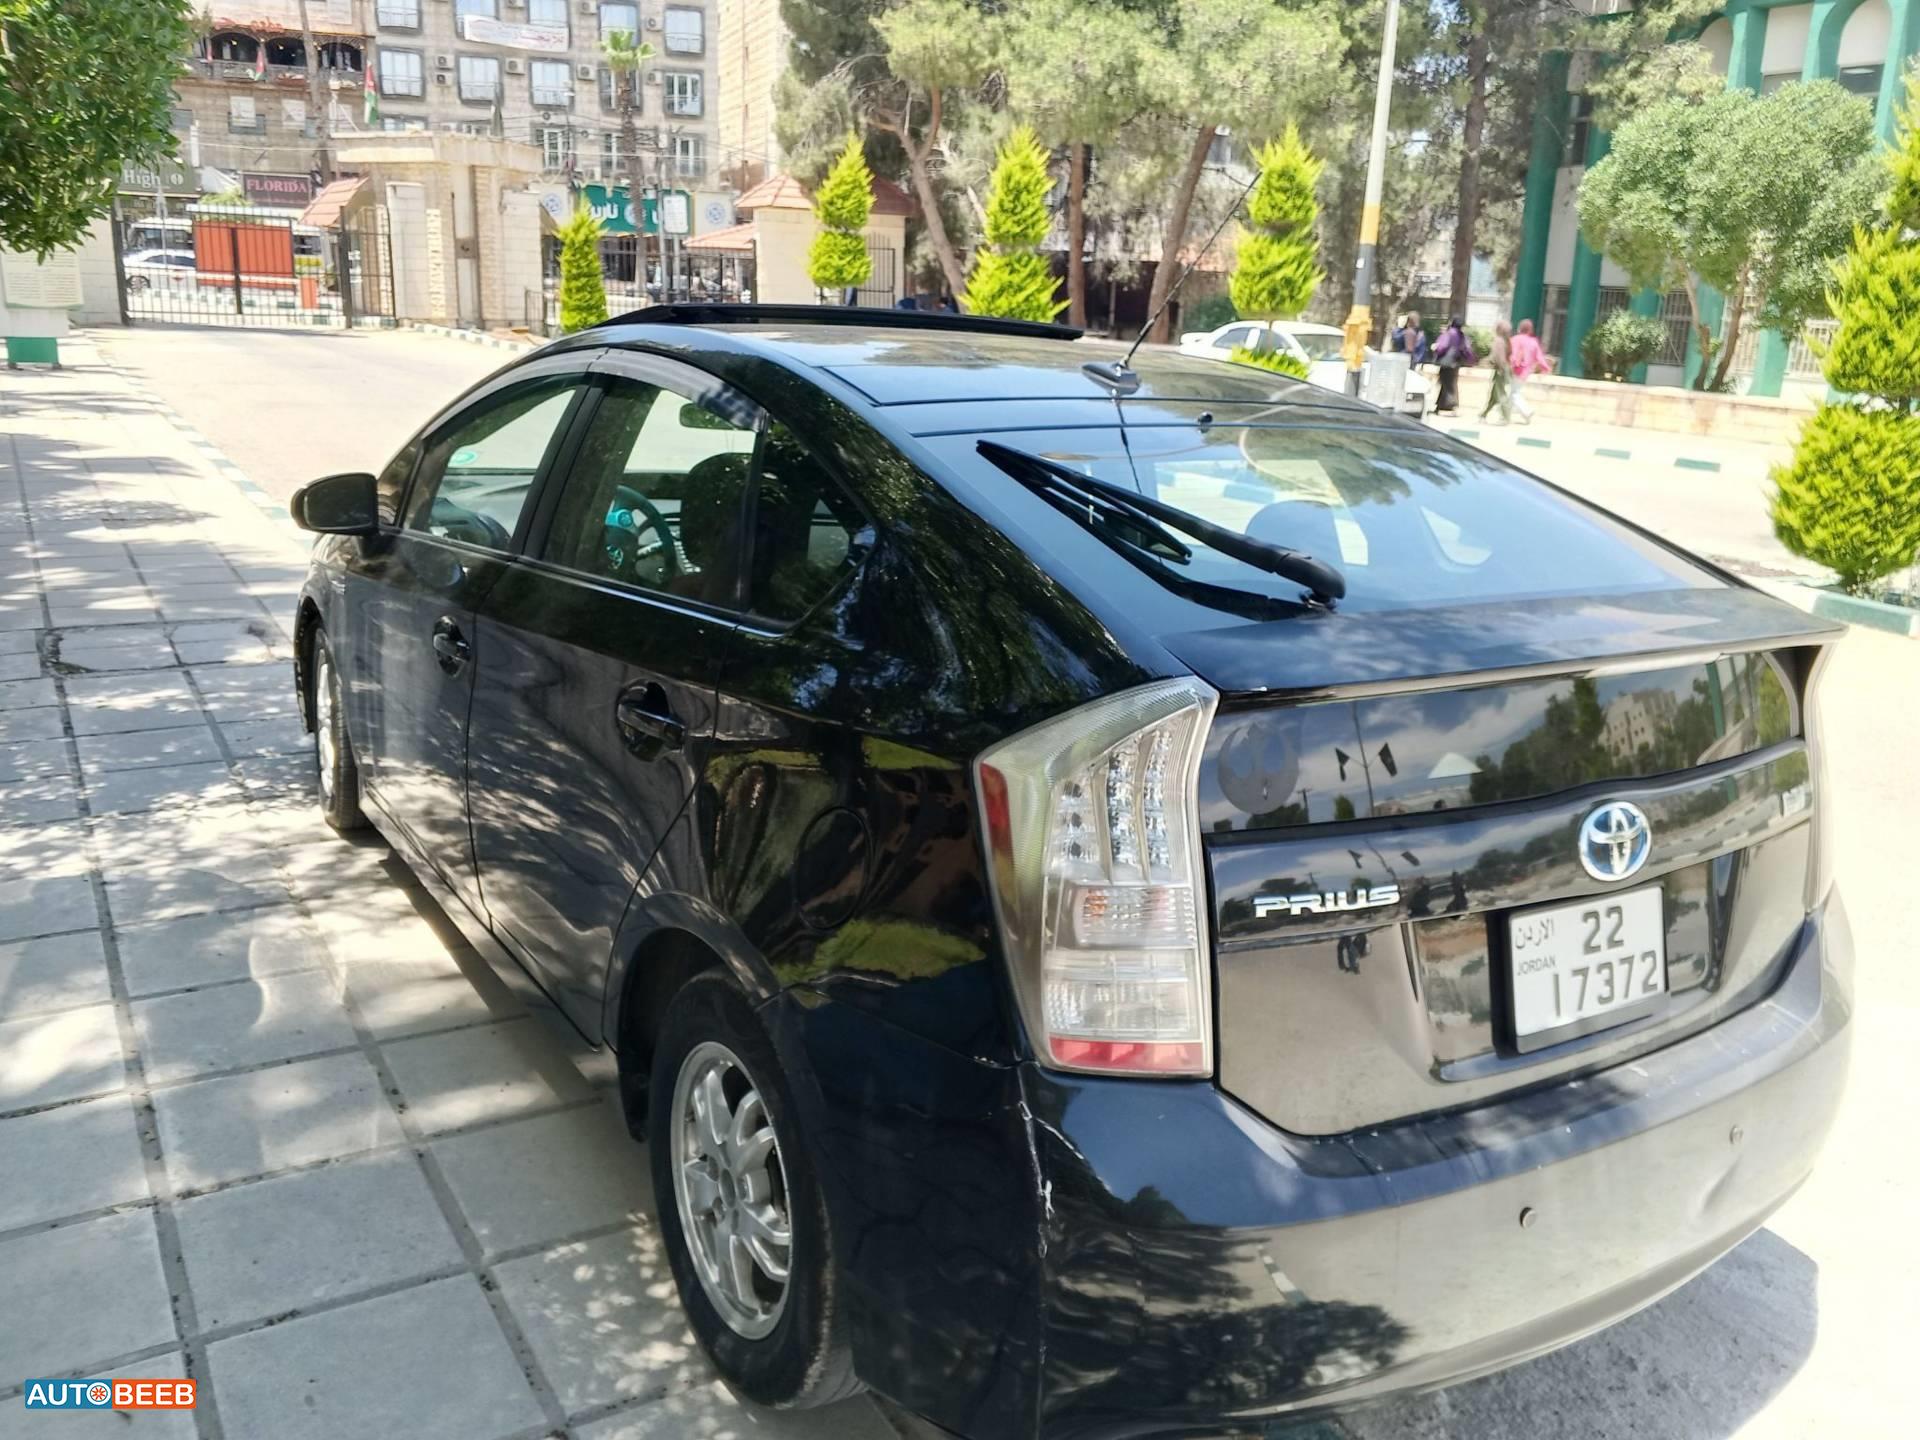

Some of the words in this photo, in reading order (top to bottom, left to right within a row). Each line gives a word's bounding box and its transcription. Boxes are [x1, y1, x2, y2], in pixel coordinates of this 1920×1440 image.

[247, 179, 307, 193] FLORIDA
[1252, 884, 1400, 917] PRIUS
[1582, 905, 1625, 955] 22
[1517, 955, 1557, 976] JORDAN
[1552, 950, 1658, 1018] 17372
